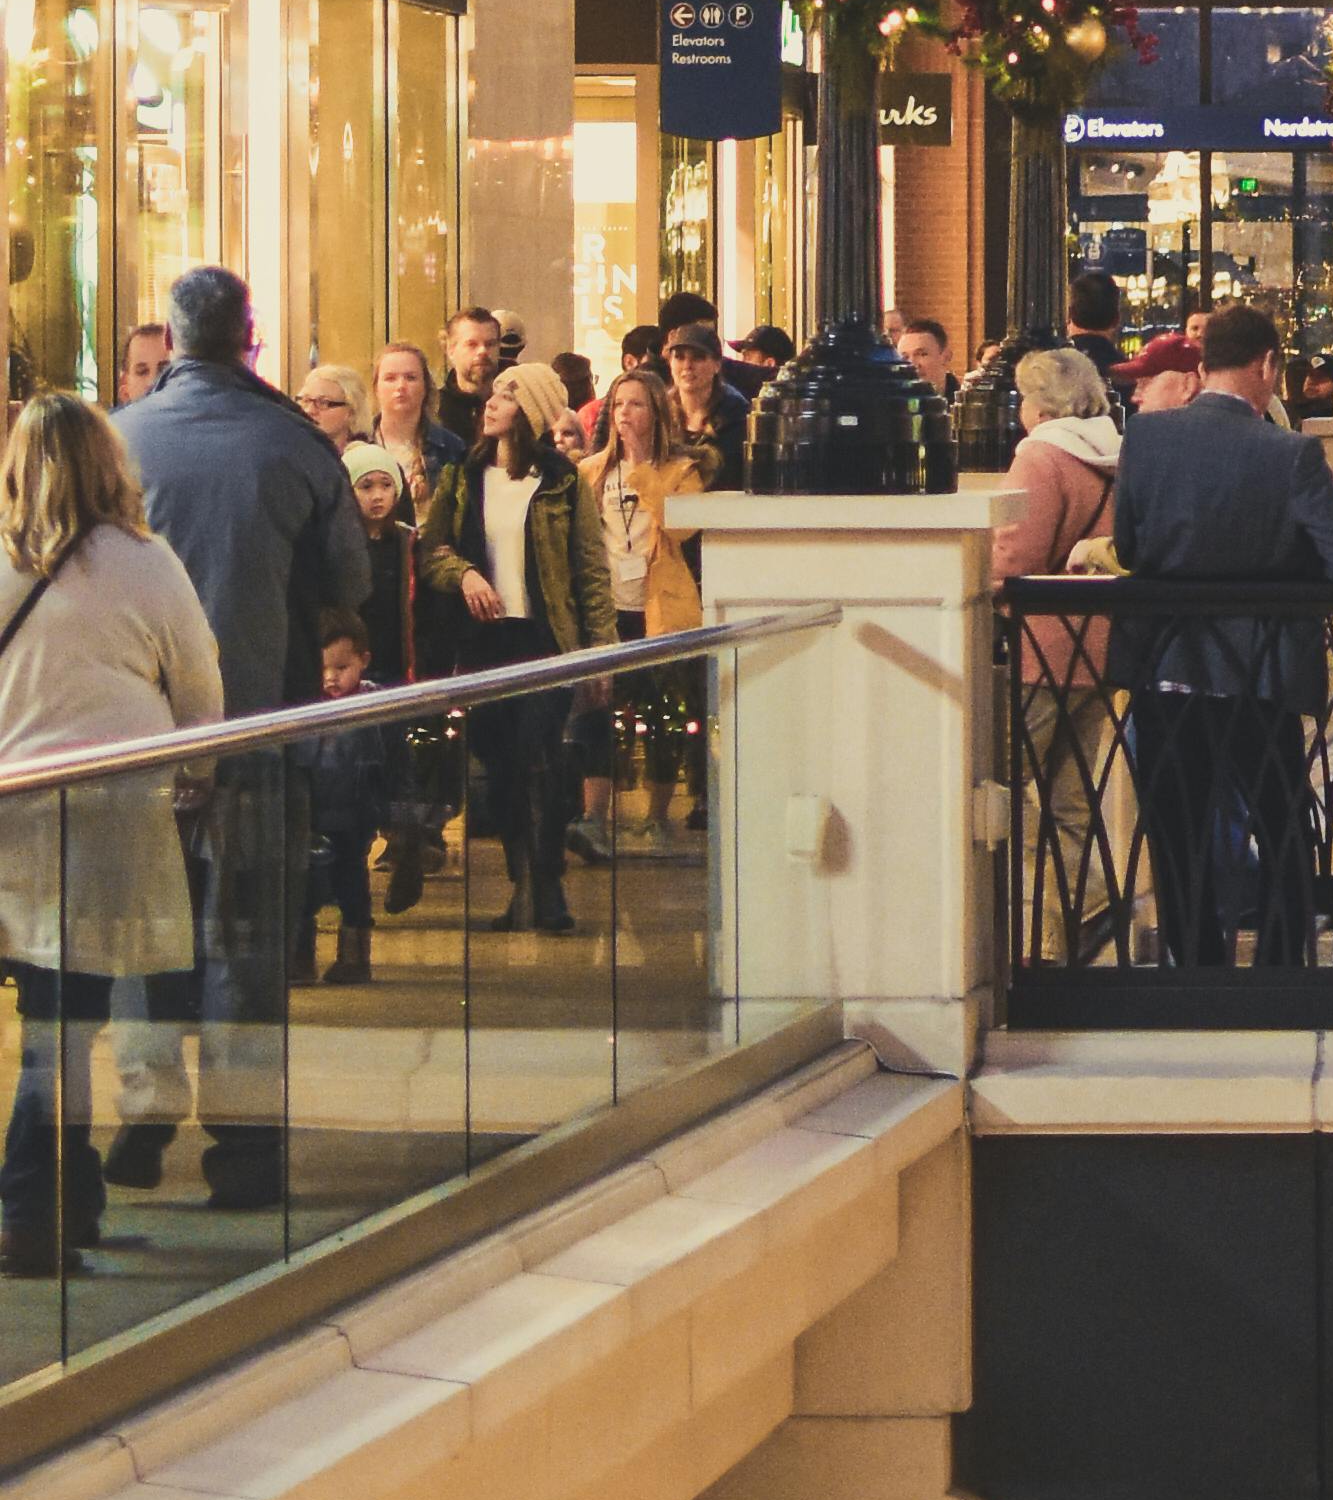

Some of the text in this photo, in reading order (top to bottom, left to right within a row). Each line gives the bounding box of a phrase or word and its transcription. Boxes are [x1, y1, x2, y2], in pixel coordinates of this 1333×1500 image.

[672, 33, 725, 47] Elevators
[671, 52, 732, 65] Restrooms
[1086, 116, 1165, 138] Elevators
